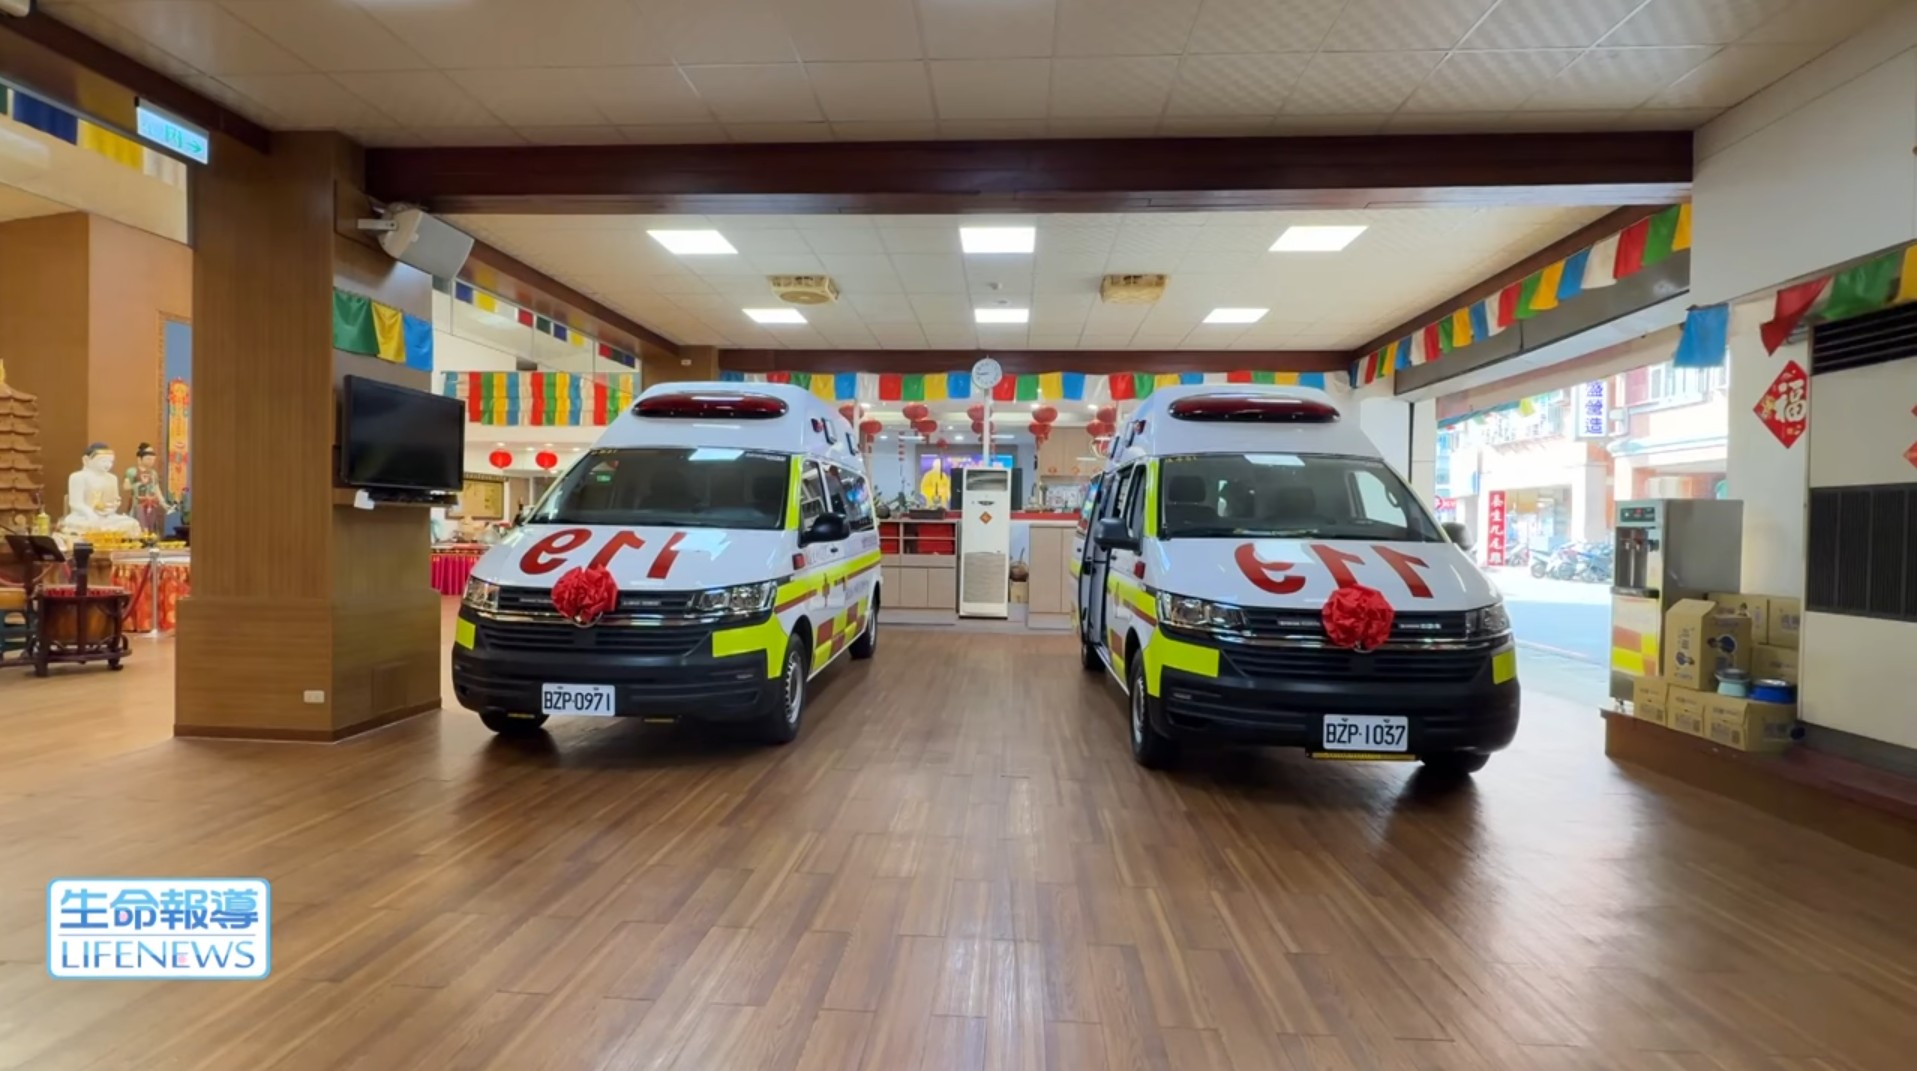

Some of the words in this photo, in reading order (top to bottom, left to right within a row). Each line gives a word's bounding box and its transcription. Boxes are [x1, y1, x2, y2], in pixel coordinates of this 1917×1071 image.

[1775, 378, 1807, 423] 福
[543, 690, 611, 712] BZP-0971
[1325, 722, 1406, 746] BZP-1037
